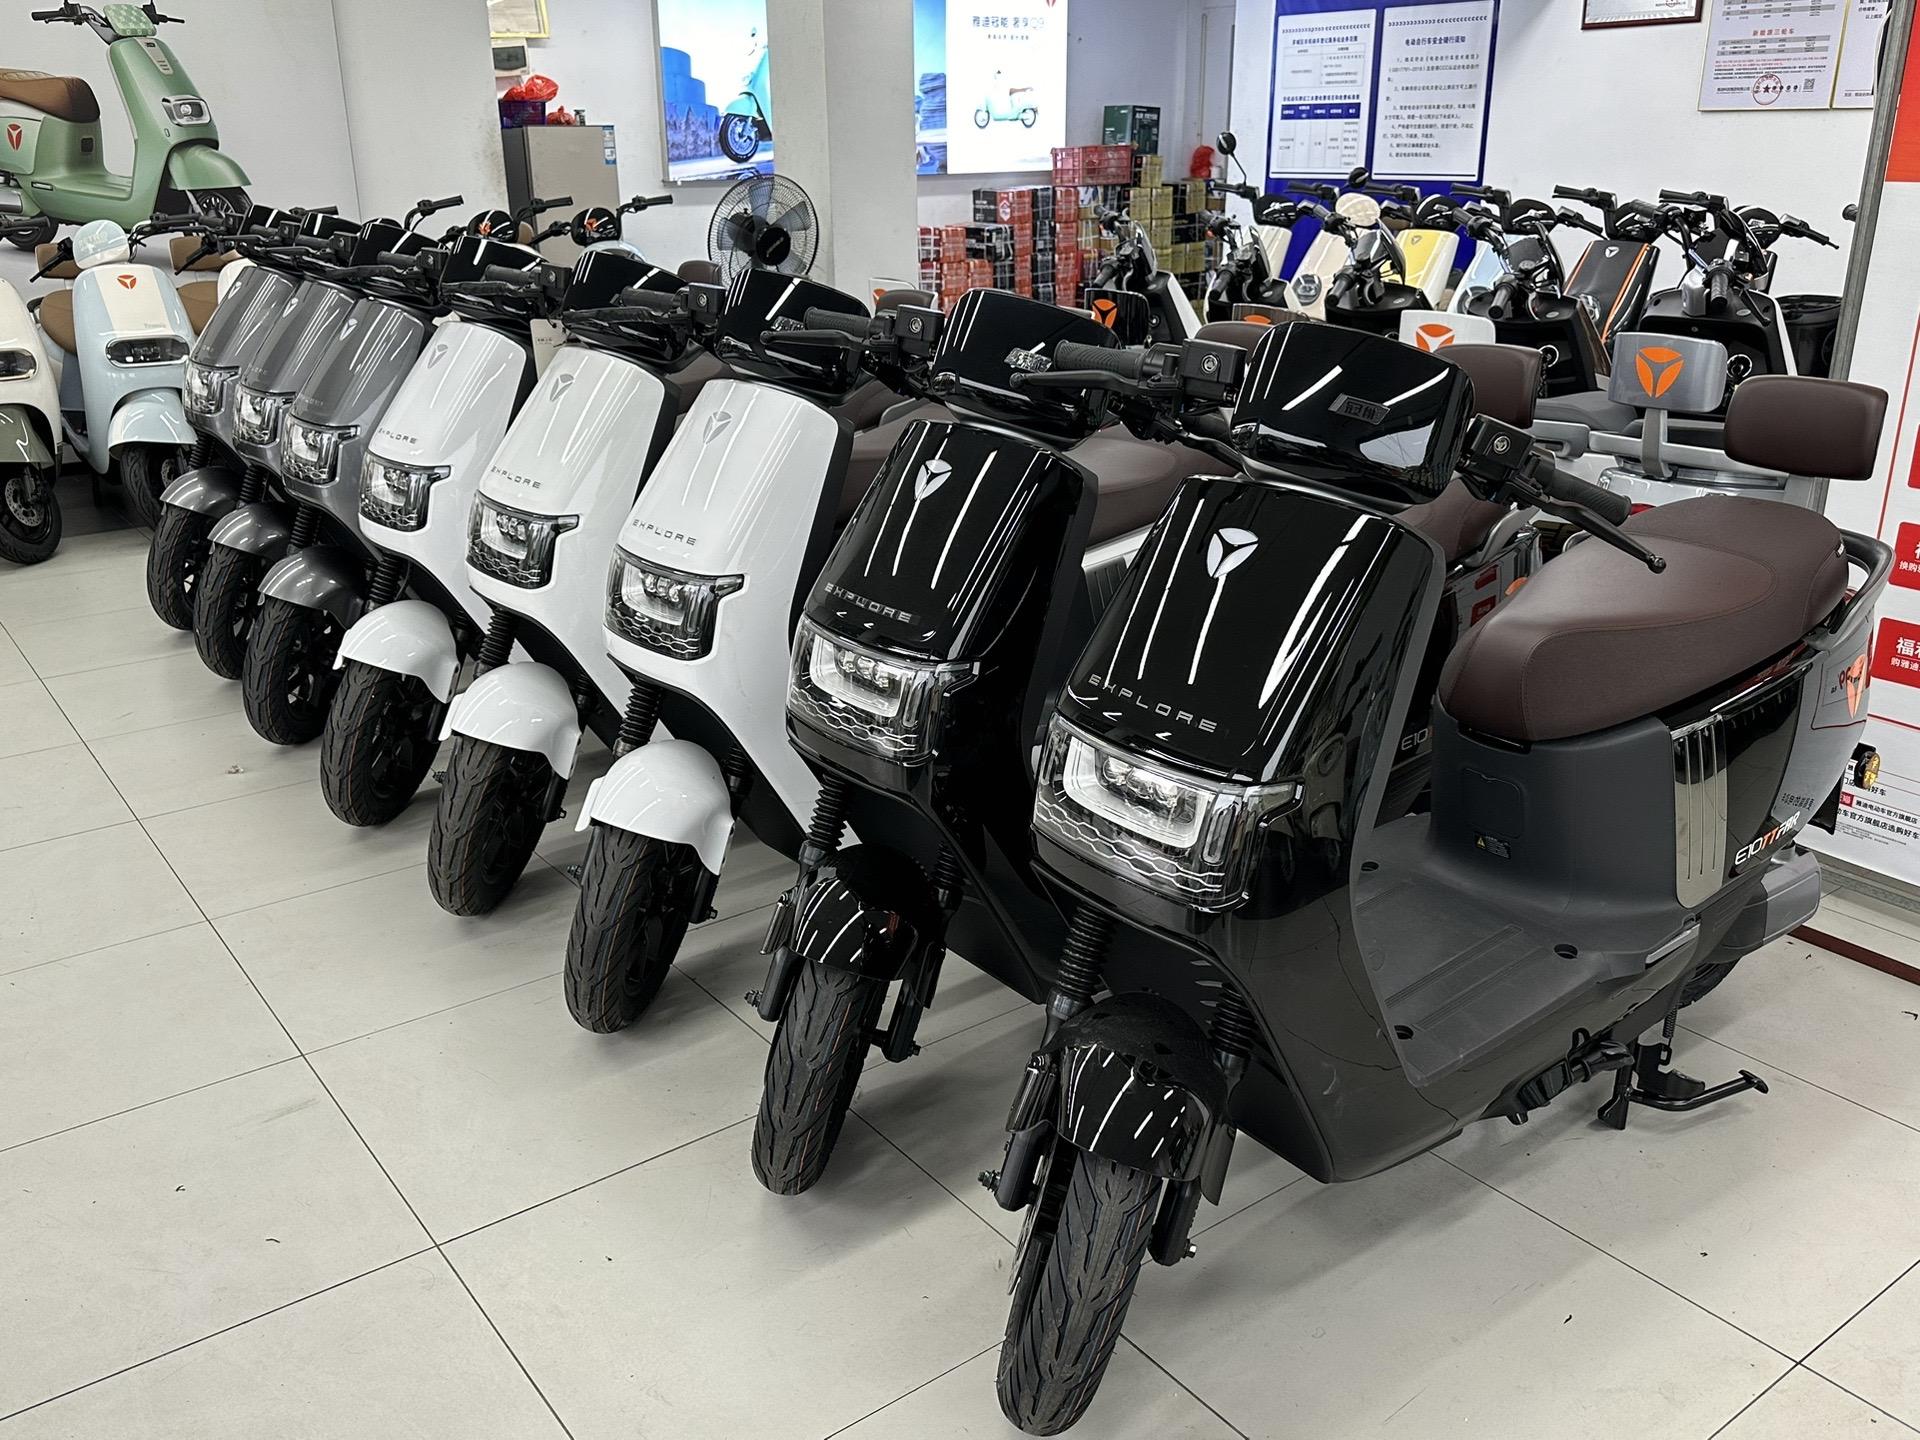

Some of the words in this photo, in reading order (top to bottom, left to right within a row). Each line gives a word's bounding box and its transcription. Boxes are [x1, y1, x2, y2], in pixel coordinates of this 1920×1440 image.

[491, 465, 542, 489] EXPLORE
[632, 518, 697, 546] EXPLORE
[824, 582, 913, 624] EXPLORE
[1890, 657, 1920, 673] 购雅迪
[1088, 673, 1218, 733] EXPLORE
[1855, 799, 1918, 825] 雅迪电动车官方旗舰店
